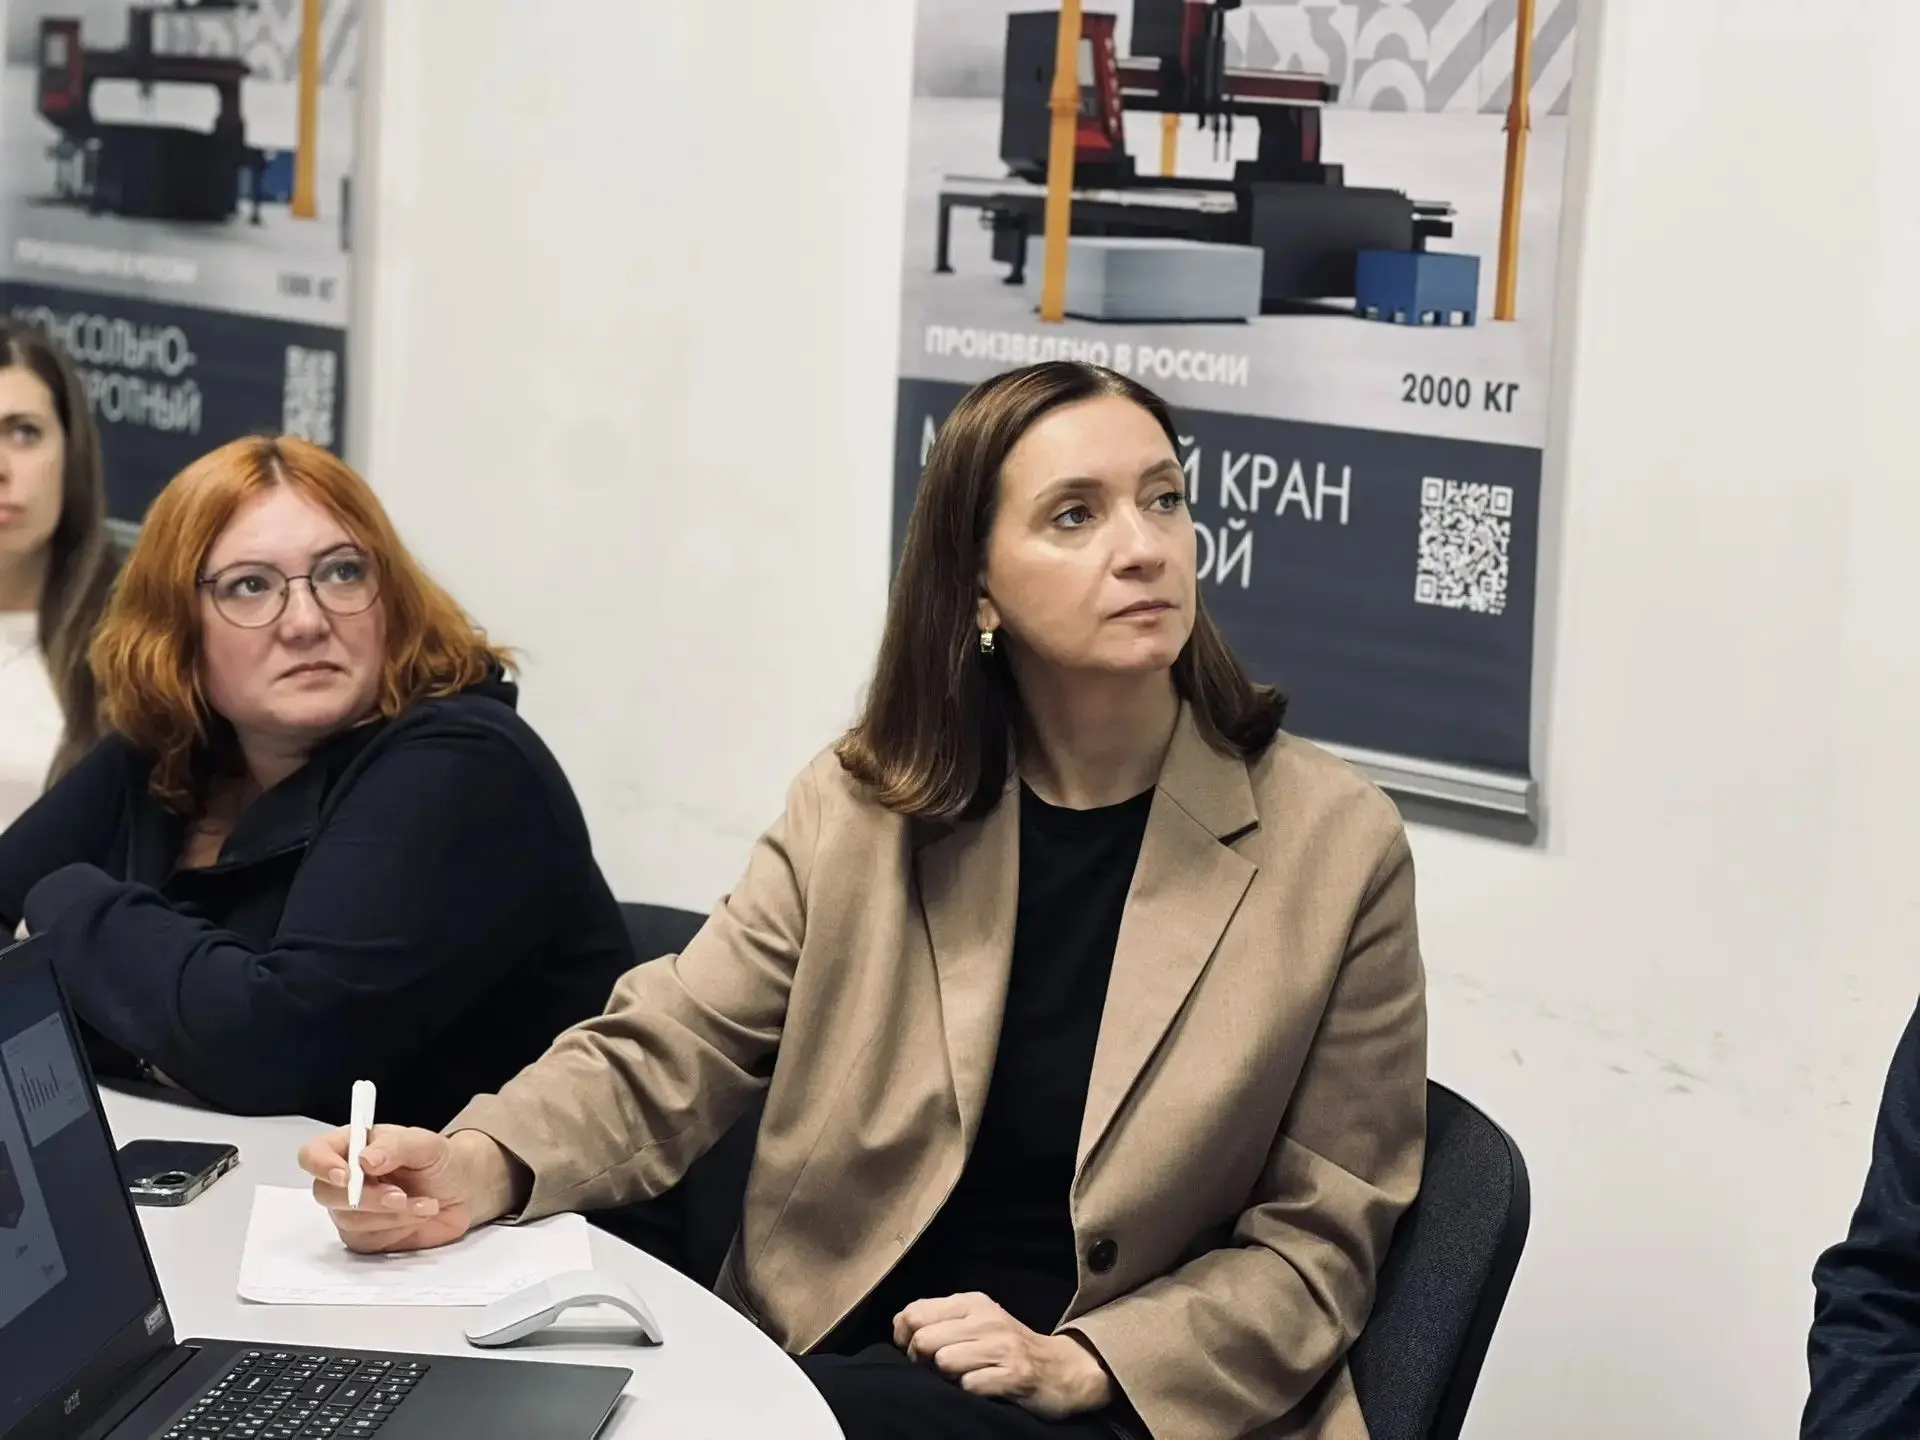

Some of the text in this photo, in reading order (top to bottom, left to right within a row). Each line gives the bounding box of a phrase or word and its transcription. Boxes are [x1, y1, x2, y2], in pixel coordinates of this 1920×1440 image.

[926, 325, 1248, 387] ПРОИЗВЕДЕНО В РОССИИ
[1402, 373, 1519, 413] 2000 КГ
[1220, 450, 1352, 525] КРАН
